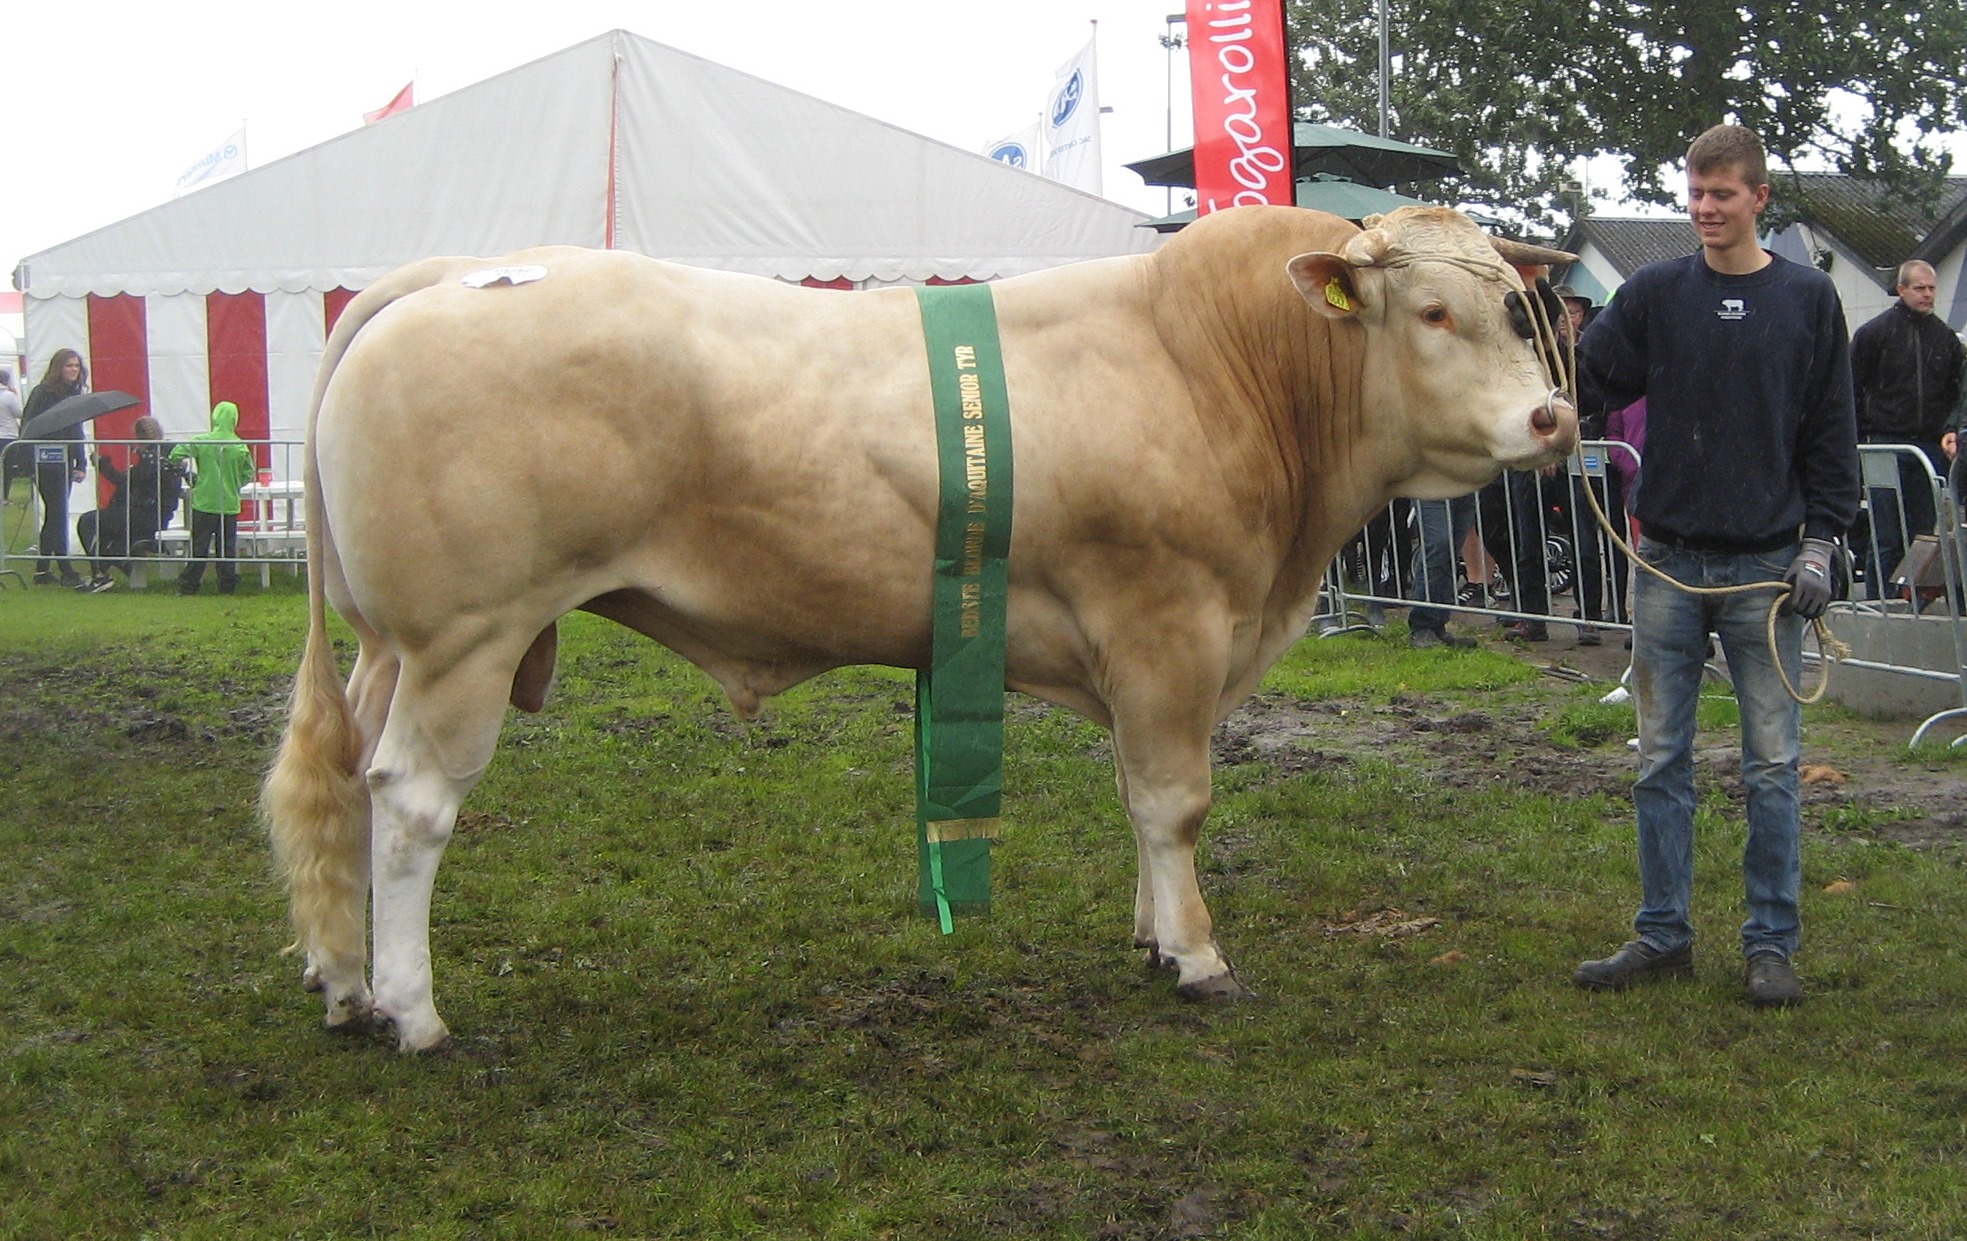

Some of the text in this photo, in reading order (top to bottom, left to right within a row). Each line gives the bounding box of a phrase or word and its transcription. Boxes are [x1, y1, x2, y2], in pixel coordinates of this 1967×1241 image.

[1206, 0, 1285, 216] ogarolli
[954, 345, 977, 370] TYR
[959, 373, 983, 420] SENIOR
[964, 424, 988, 514] D'AQUITAINE
